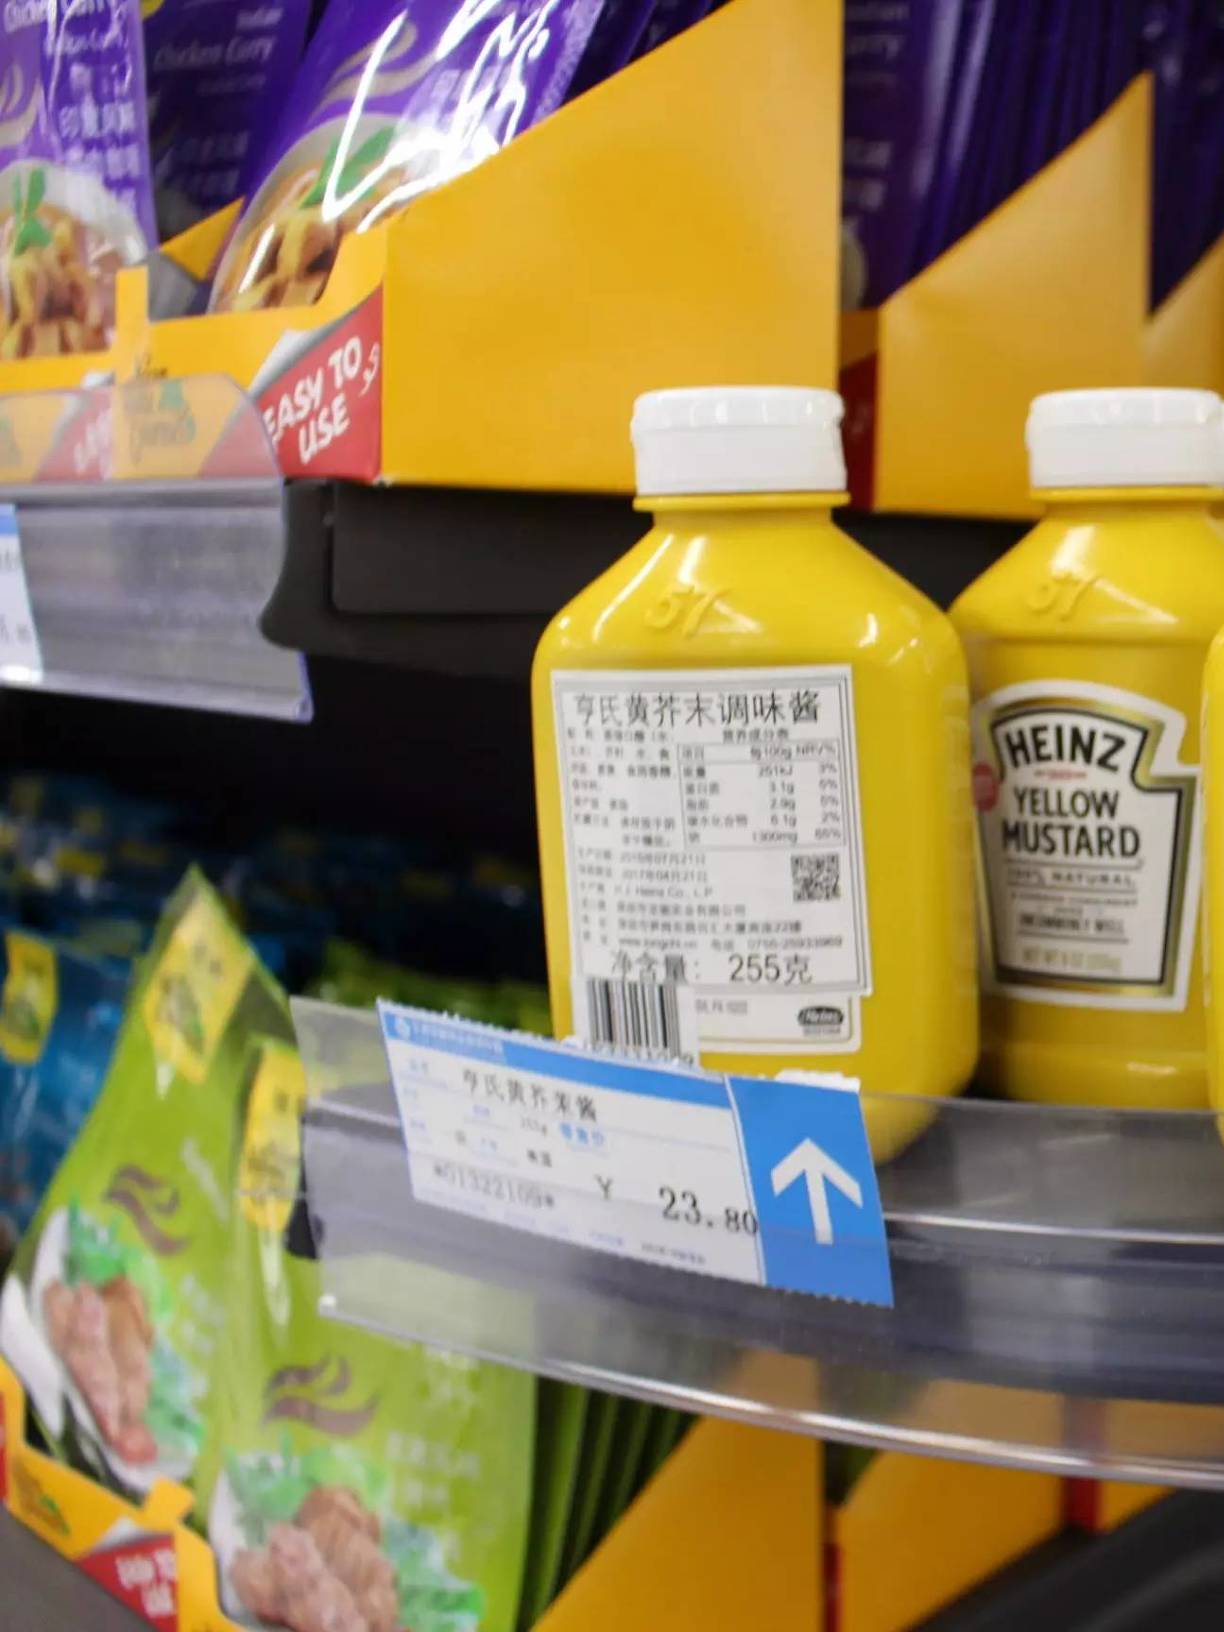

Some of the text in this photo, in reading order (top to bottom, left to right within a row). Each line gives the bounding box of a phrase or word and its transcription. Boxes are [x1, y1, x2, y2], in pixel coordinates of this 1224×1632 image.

[327, 335, 363, 391] TO
[298, 392, 352, 466] USE
[1005, 723, 1127, 773] HEINZ
[1013, 785, 1120, 820] YELLOW
[1002, 819, 1141, 859] MUSTARD
[728, 952, 814, 986] 255克
[658, 1184, 759, 1236] 23.80
